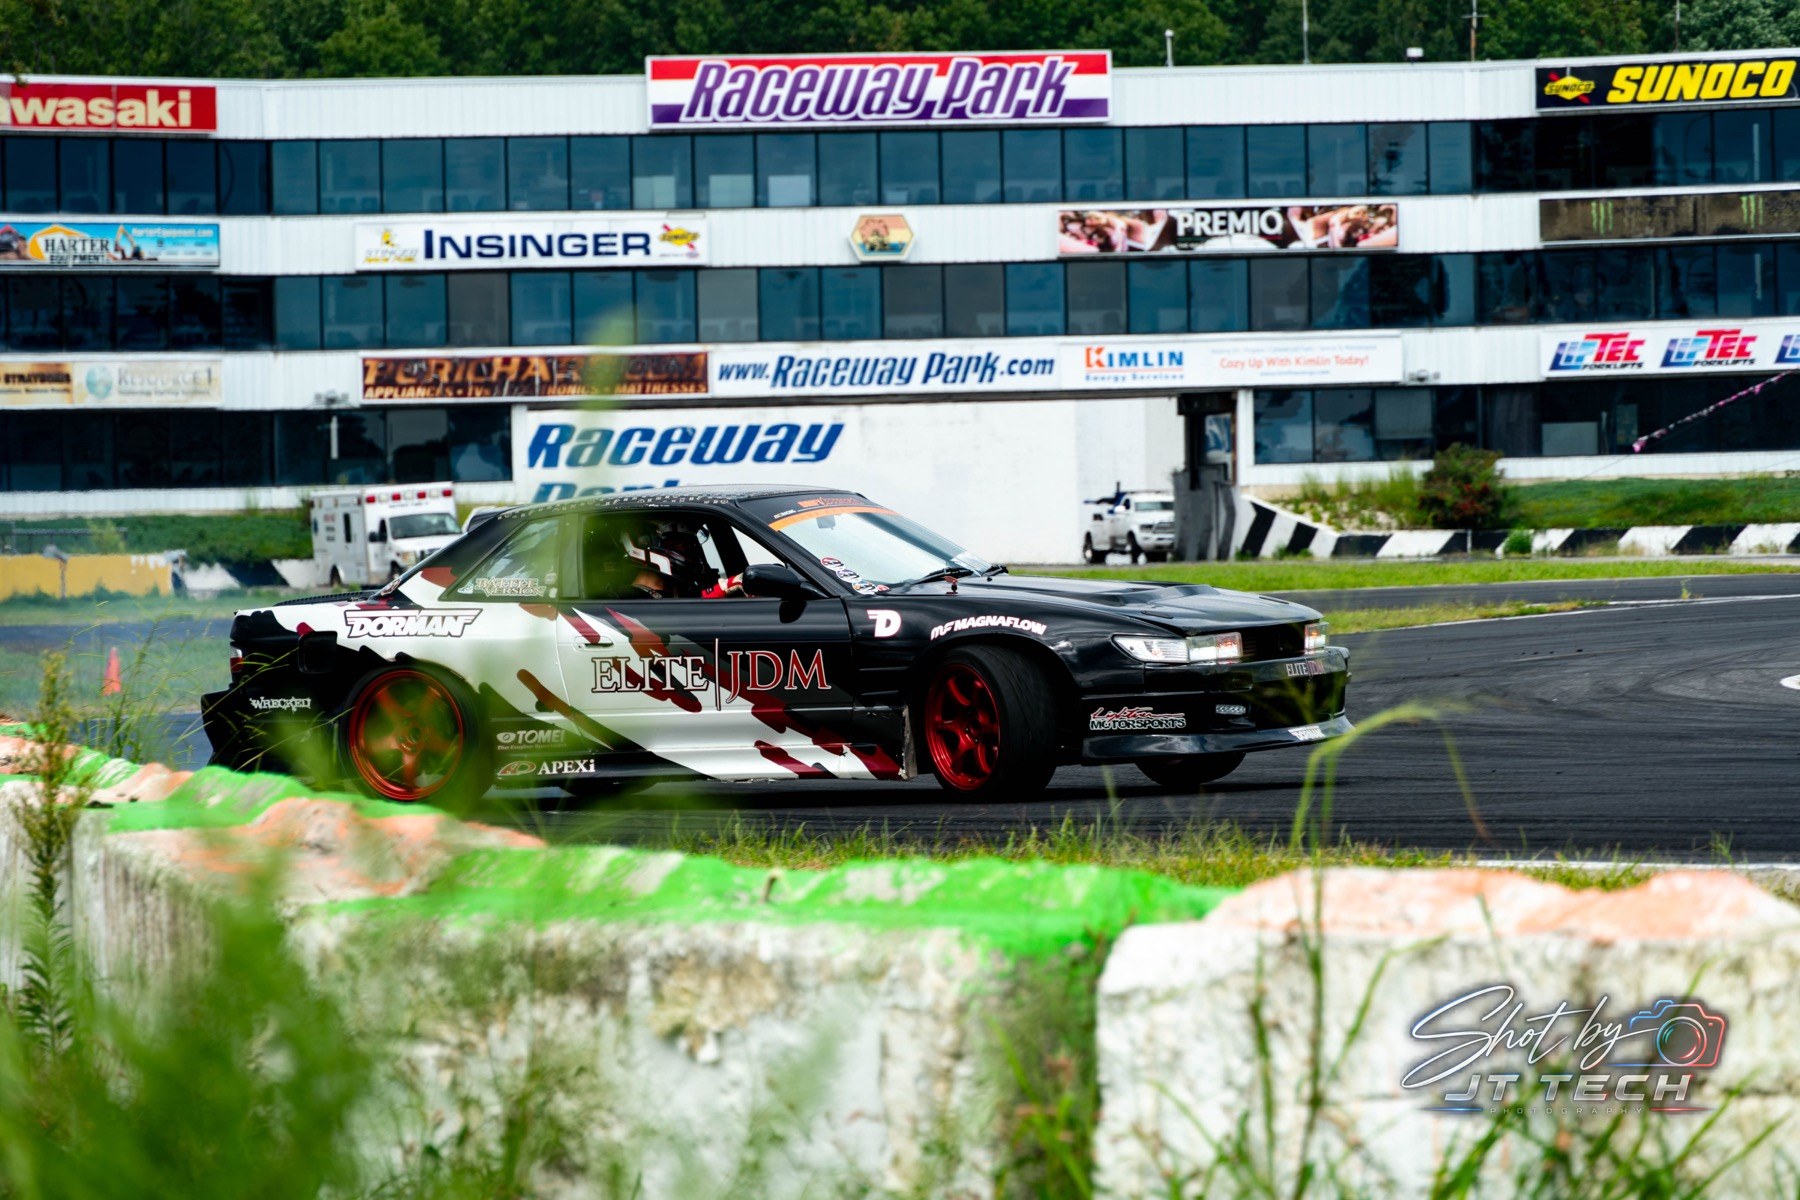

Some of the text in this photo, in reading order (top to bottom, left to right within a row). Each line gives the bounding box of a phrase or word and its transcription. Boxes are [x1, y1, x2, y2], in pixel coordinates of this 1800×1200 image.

[682, 56, 1076, 121] Raceway Park
[1547, 82, 1593, 95] SUNOCO
[1606, 60, 1797, 104] SUNOCO
[1177, 209, 1283, 237] PREMIO
[44, 238, 110, 252] HARTER
[424, 230, 651, 260] INSINGER
[1085, 347, 1184, 368] KIMLIN
[1220, 354, 1369, 370] Cozy Up With Kimlin Today!
[1692, 358, 1756, 367] FORKLIFTS
[1581, 361, 1645, 371] FORKLIFTS
[1085, 373, 1185, 383] Energy Services
[614, 382, 708, 395] MATTRESSES
[527, 422, 846, 469] Raceway
[475, 578, 539, 590] BATTLE
[484, 586, 547, 597] VERSION
[346, 614, 480, 638] DORMAN
[954, 615, 1048, 635] MAGNAFLOW
[591, 649, 832, 704] ELITE JDM
[1286, 662, 1308, 677] ELITE
[250, 696, 312, 712] WRECKED
[1089, 717, 1187, 730] MOTORSPORTS
[516, 729, 566, 744] TOMEI
[537, 759, 596, 775] APEXi
